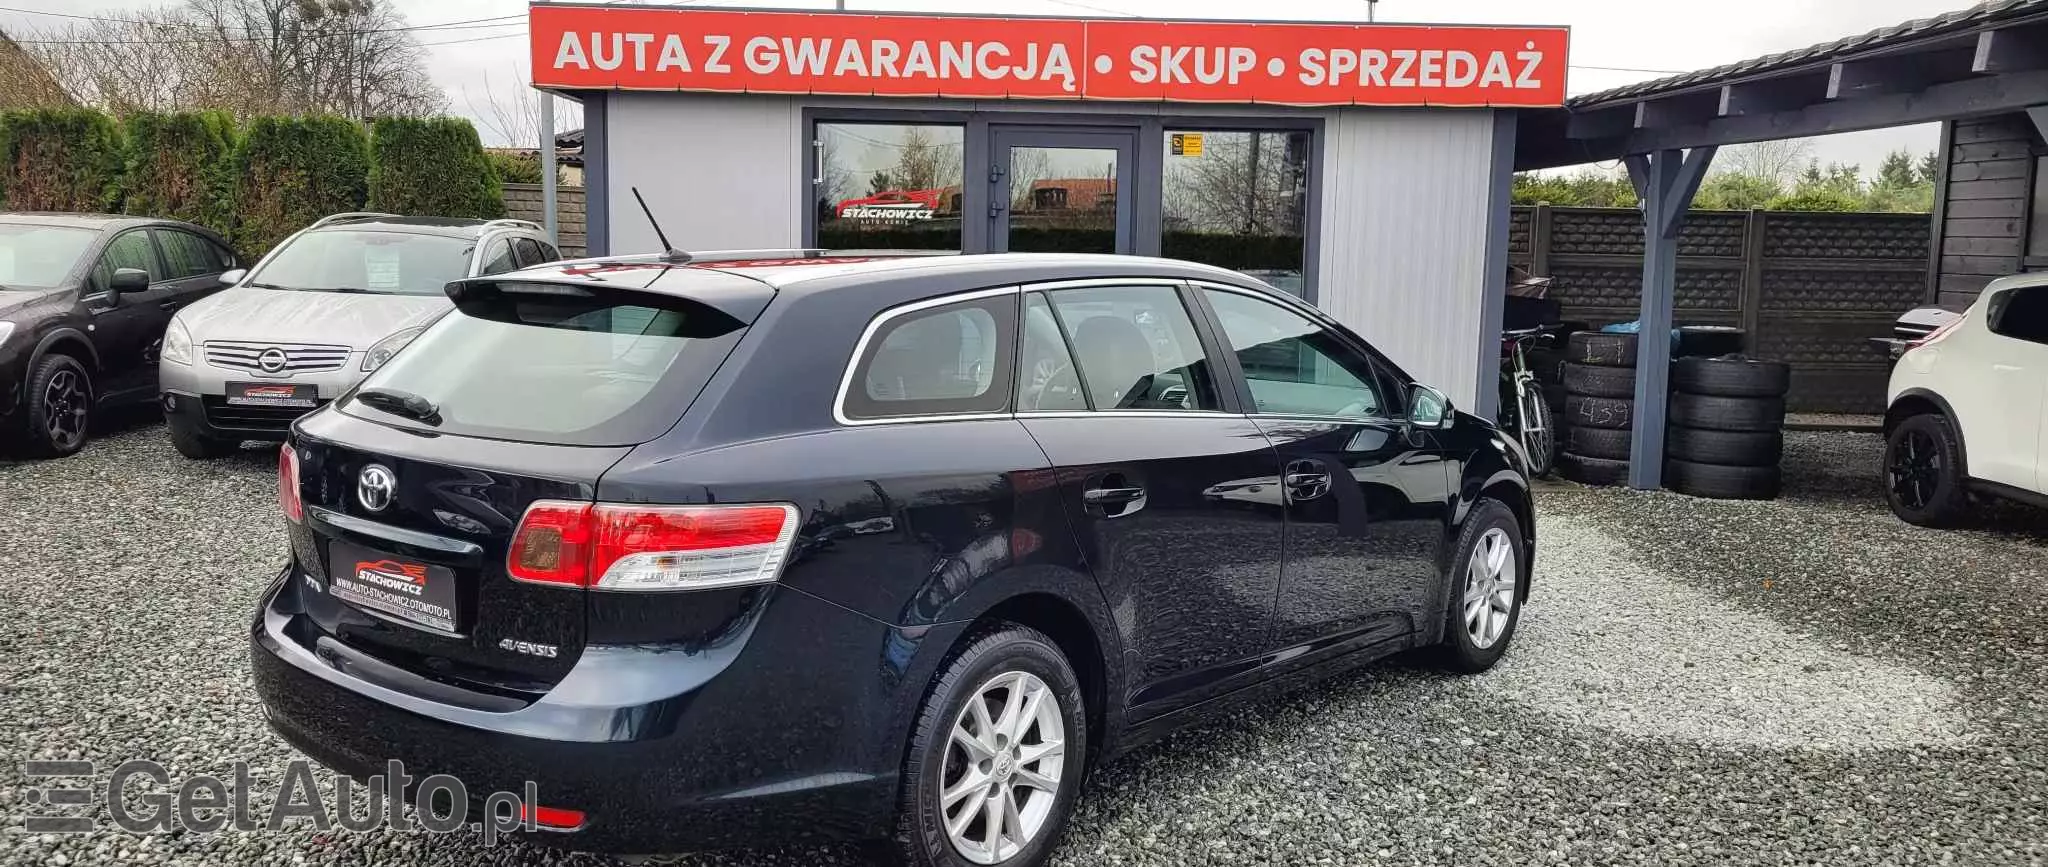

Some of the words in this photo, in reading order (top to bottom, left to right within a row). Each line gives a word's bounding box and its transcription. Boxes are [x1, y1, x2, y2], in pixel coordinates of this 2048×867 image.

[552, 31, 692, 73] AUTA
[703, 35, 731, 73] Z
[743, 36, 1076, 91] GWARANCJĄ
[1129, 45, 1257, 85] SKUP
[1298, 41, 1544, 89] SPRZEDAŻ
[841, 208, 935, 219] STACHOWICZ
[358, 570, 423, 595] STACHOWICZ
[499, 638, 559, 658] AVENSIS
